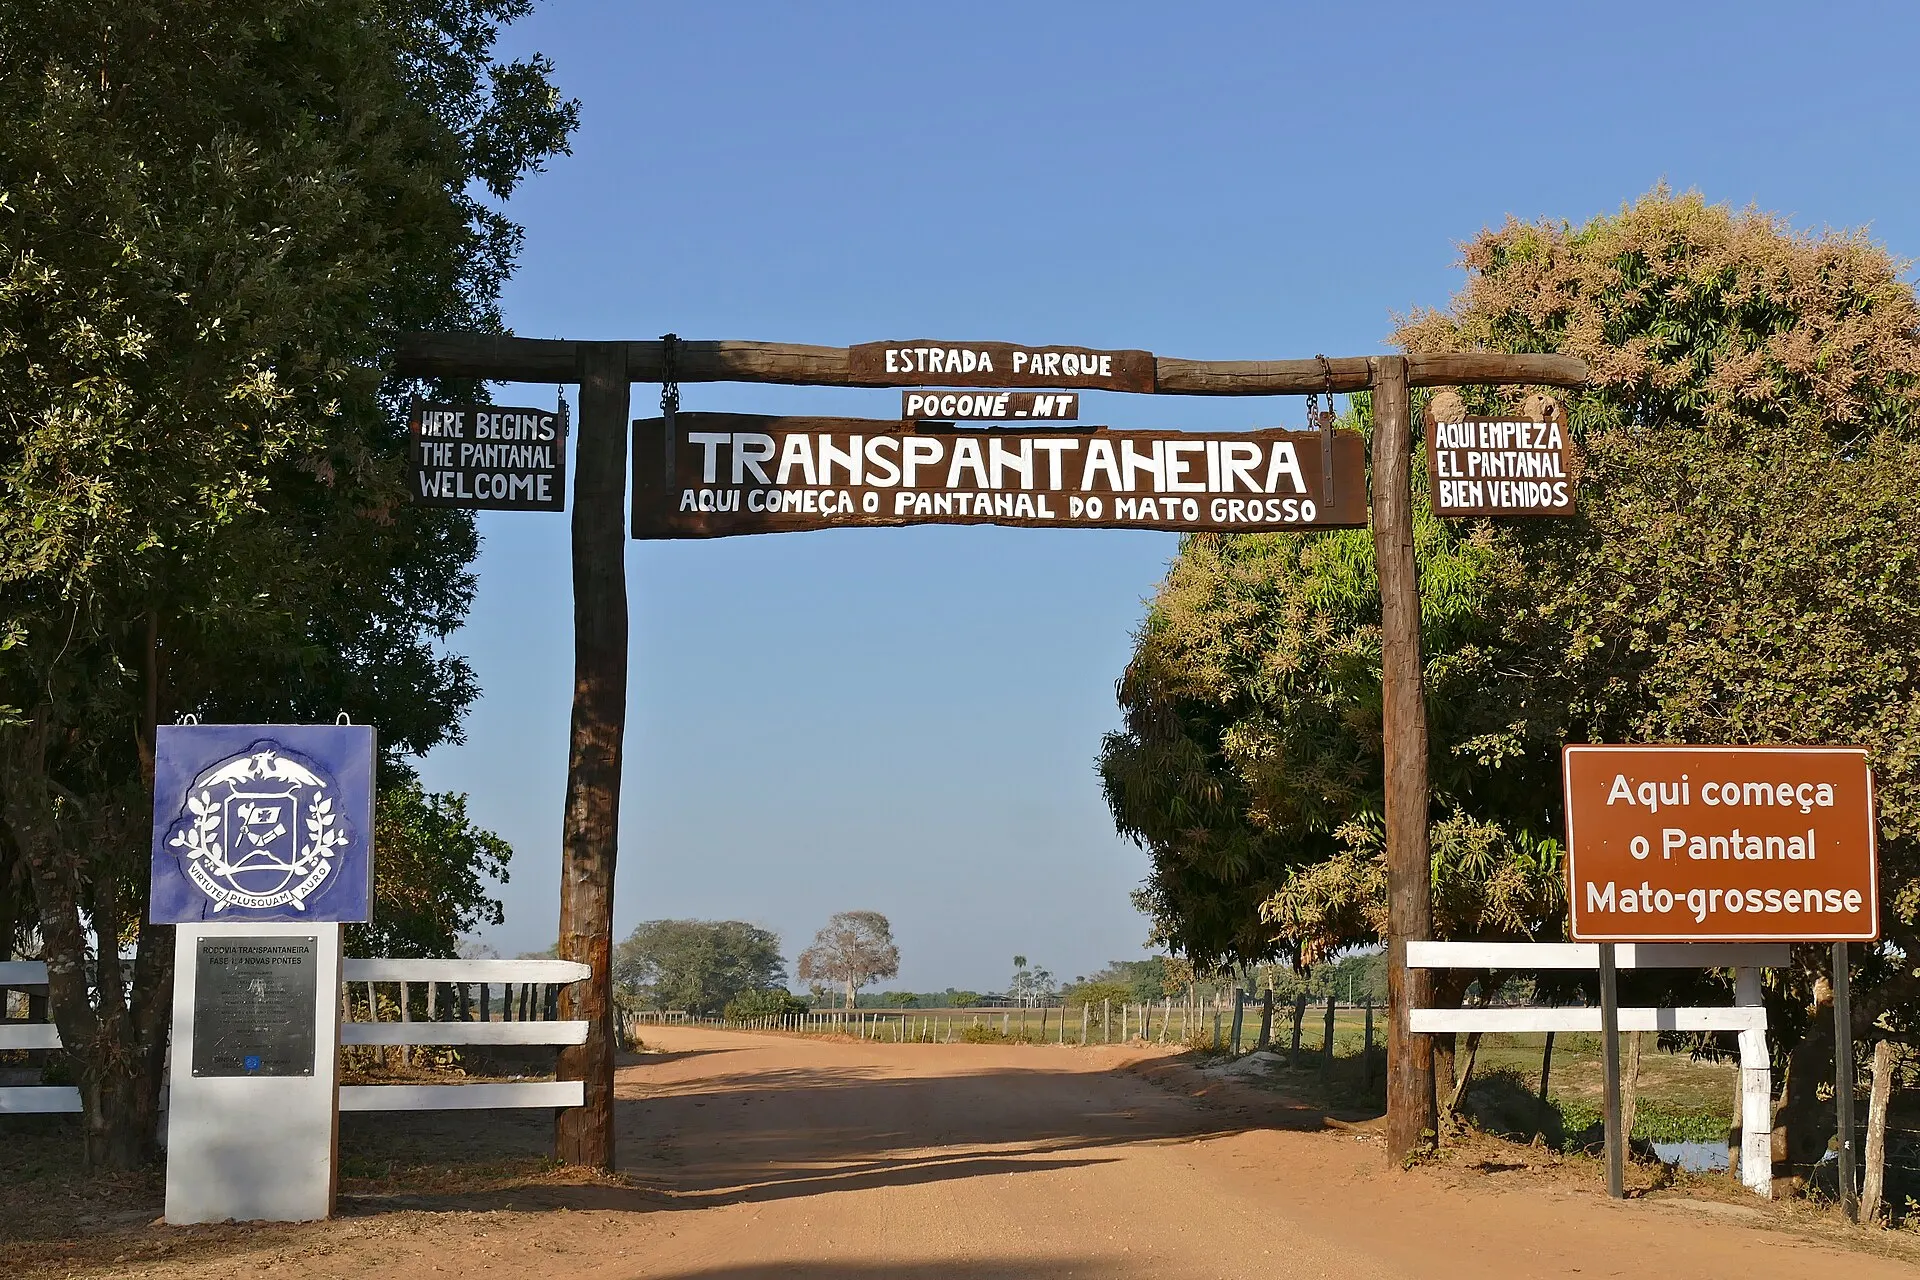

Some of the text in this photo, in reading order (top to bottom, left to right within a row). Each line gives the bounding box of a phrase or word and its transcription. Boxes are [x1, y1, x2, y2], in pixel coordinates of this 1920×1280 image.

[885, 348, 1112, 377] ESTRADA PARQUE
[907, 392, 1011, 417] POCONÉ
[1031, 395, 1074, 417] MT
[421, 410, 556, 441] HERE BEGINS
[1436, 422, 1563, 449] AQUI EMPIEZA
[420, 442, 555, 469] THE PANTANAL
[688, 432, 1307, 493] TRANSPANTANEIRA
[1437, 451, 1566, 478] EL PANTANAL
[419, 470, 553, 501] WELCOME
[1439, 480, 1569, 508] BIEN VENIDOS
[679, 489, 1316, 523] AQUI COMEÇA O PANTANAL DO MATO GROSSO
[1606, 774, 1834, 814] Aqui começa
[1629, 828, 1816, 860] o Pantanal
[190, 865, 327, 907] VIRTUTE PLUSQUAM AURO
[1586, 881, 1863, 924] Mato-grossense
[203, 946, 310, 954] RODOVIA TRANSPANTANEIRA
[209, 957, 229, 965] FASE
[271, 957, 302, 965] PONTES
